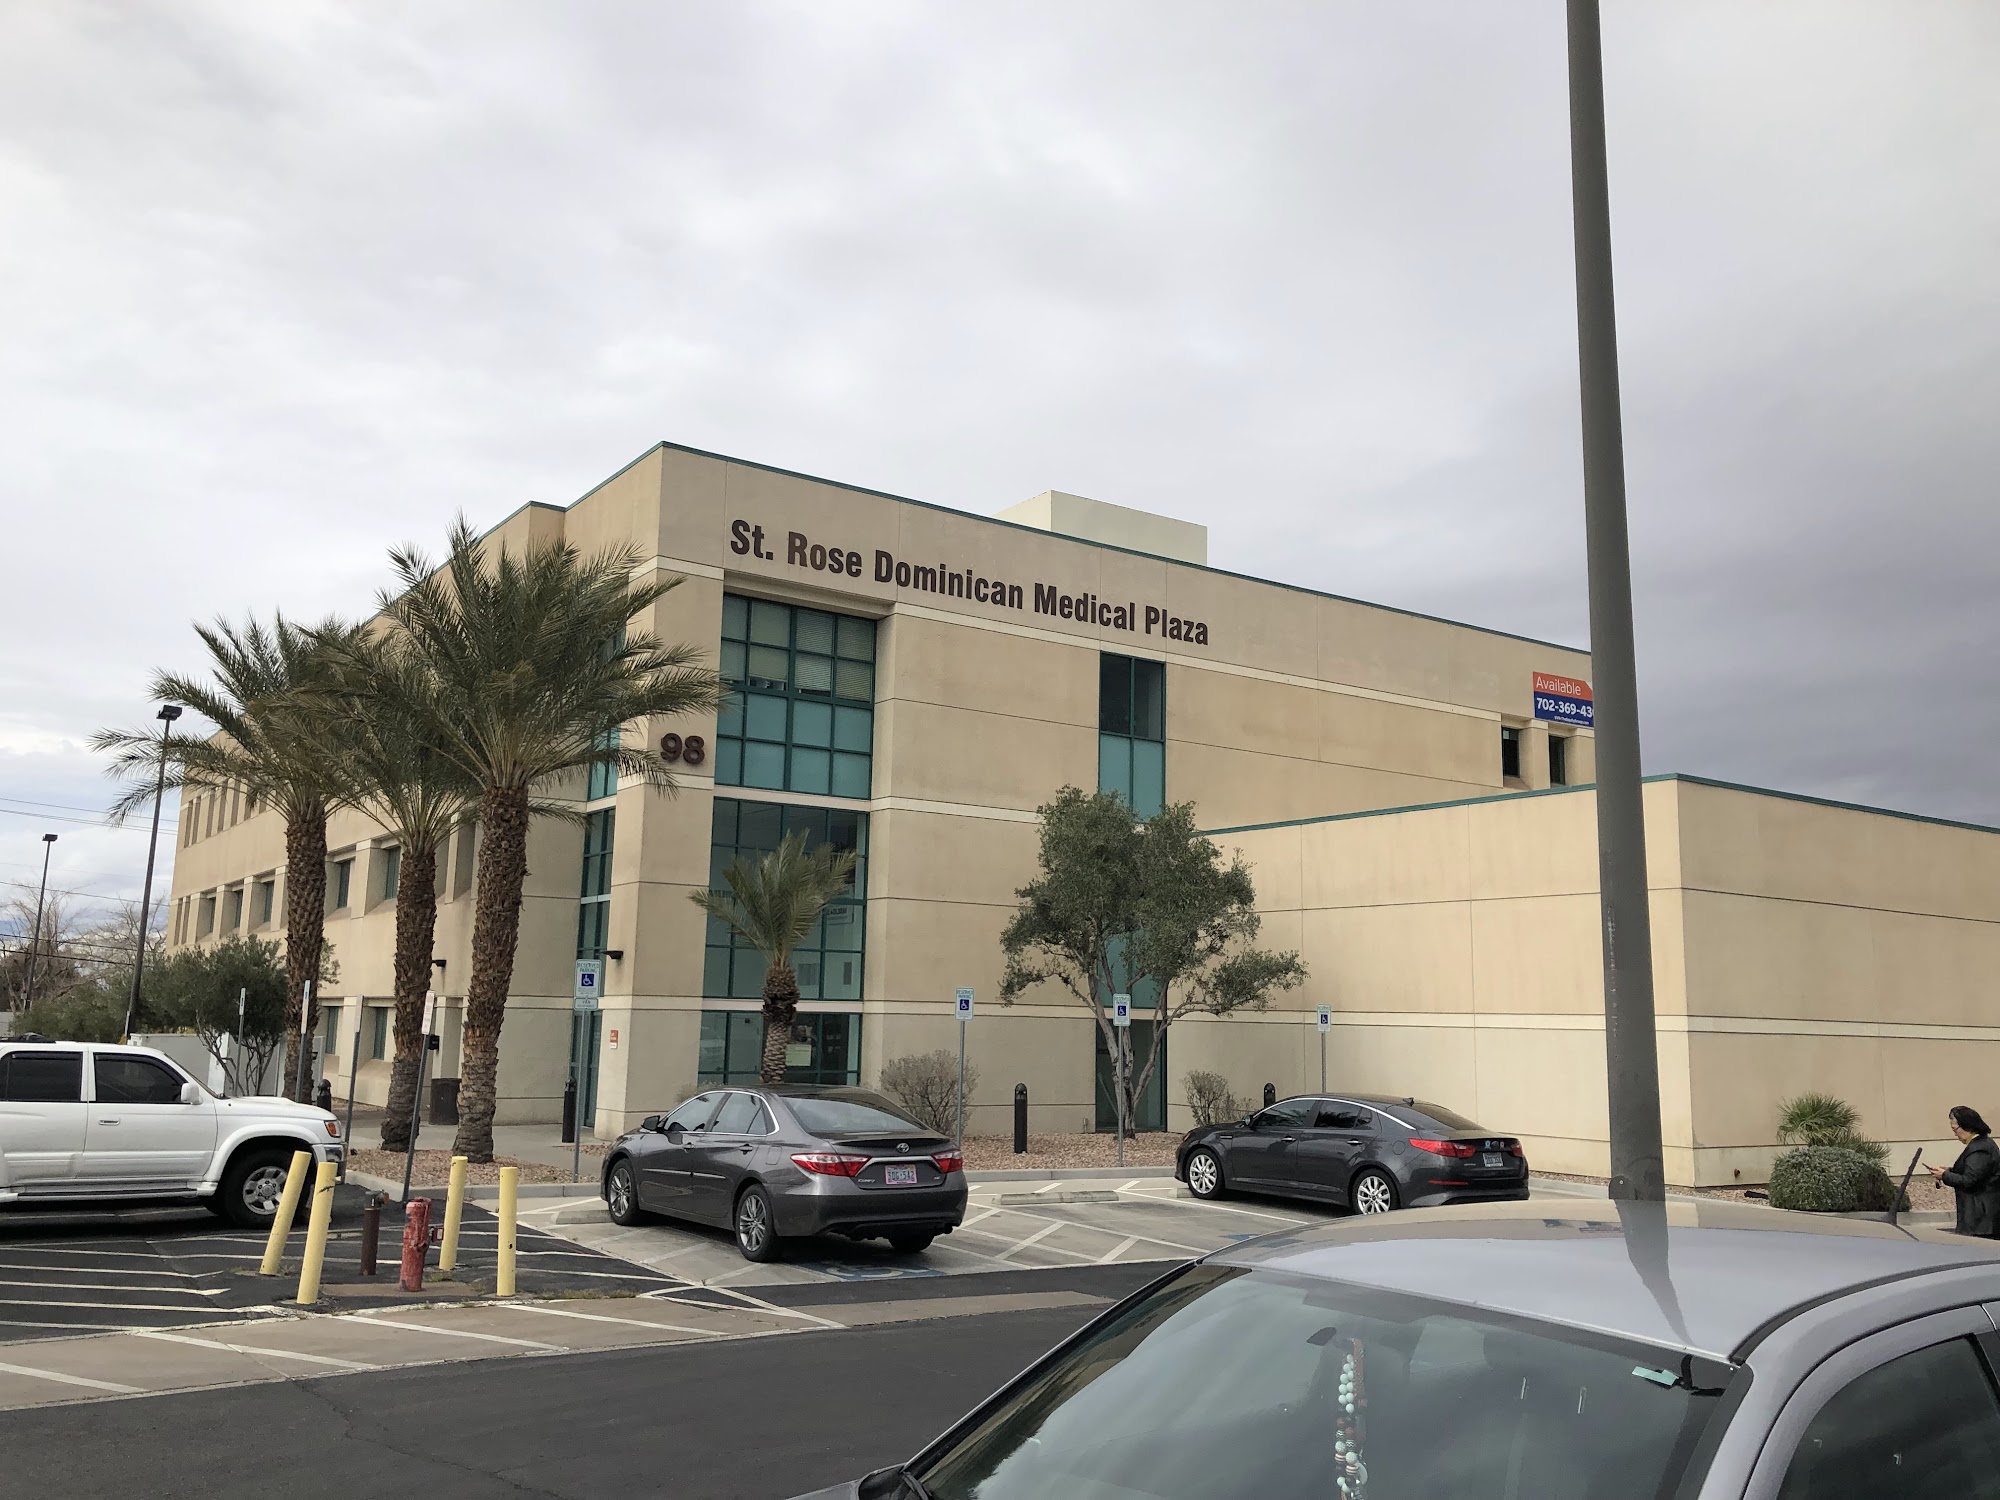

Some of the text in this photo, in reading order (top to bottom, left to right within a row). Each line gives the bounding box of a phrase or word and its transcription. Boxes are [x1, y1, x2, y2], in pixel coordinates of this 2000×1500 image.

[730, 518, 1210, 646] St. Rose Dominican Medical Plaza
[1536, 676, 1581, 696] Available
[1536, 697, 1594, 718] 702-369-43
[660, 732, 705, 764] 98
